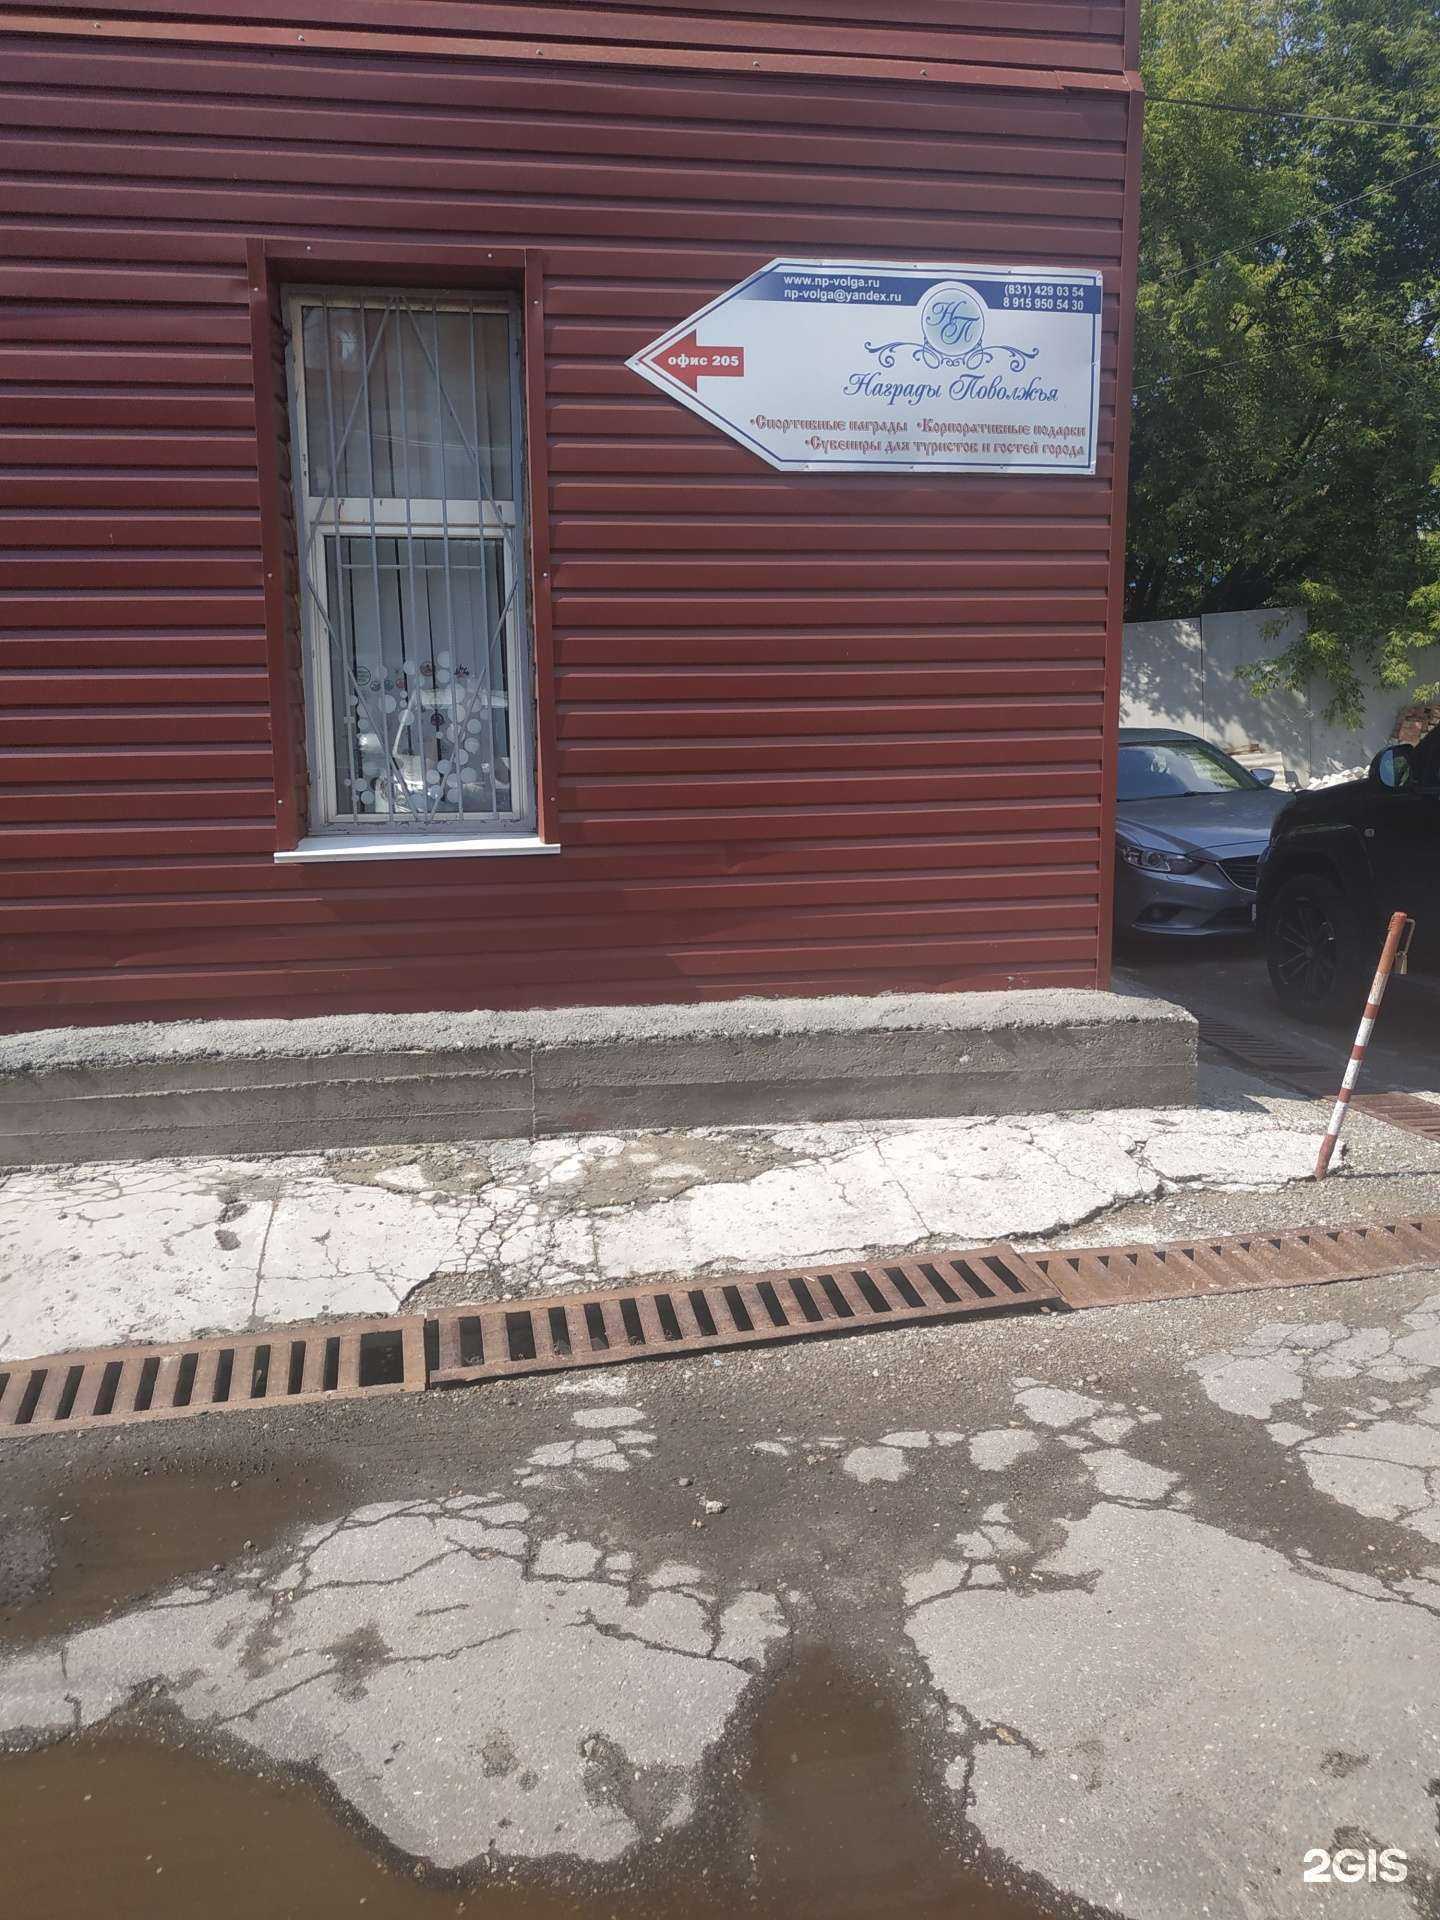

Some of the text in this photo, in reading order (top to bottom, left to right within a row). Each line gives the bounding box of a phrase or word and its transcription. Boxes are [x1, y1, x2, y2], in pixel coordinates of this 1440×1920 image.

[783, 275, 880, 289] www.np-volga.ru
[784, 289, 902, 302] np-volga@yandex.ru
[1004, 284, 1084, 297] (831) 429 03 54
[1003, 297, 1084, 310] 8 915 950 54 30
[668, 354, 740, 368] офис 205
[843, 372, 1059, 406] Награды Поволжья
[849, 419, 908, 435] награды
[1033, 425, 1086, 440] подарки
[810, 435, 1085, 458] Сувениры для туристов и гостей города
